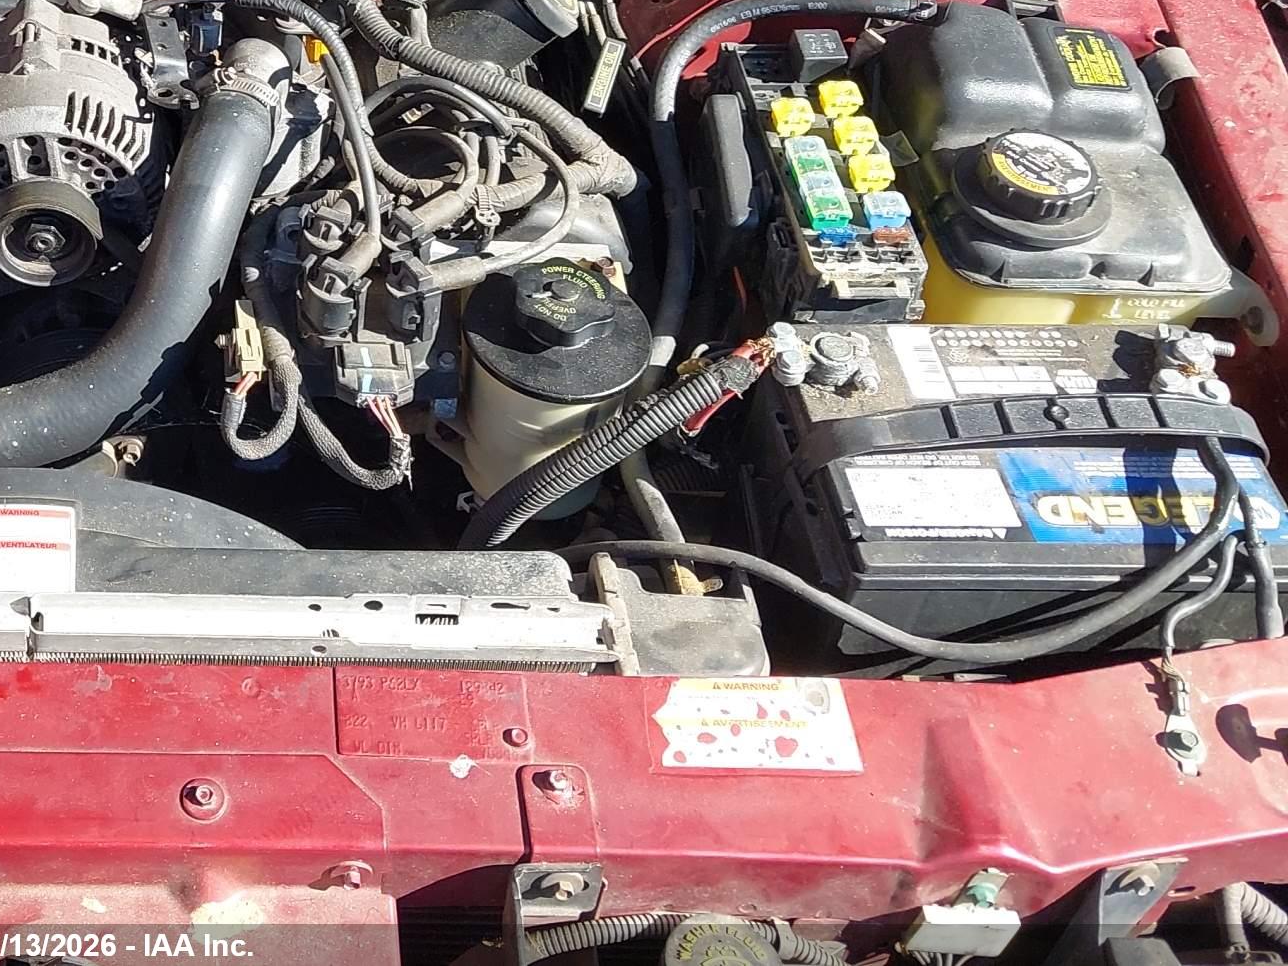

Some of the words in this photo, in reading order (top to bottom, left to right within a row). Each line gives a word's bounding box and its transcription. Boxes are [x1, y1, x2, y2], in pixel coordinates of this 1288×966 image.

[541, 265, 575, 275] POWER
[562, 274, 589, 289] FLUID
[0, 509, 40, 517] WARNING
[0, 541, 57, 550] VENTILATEUR
[723, 682, 779, 692] WARNING
